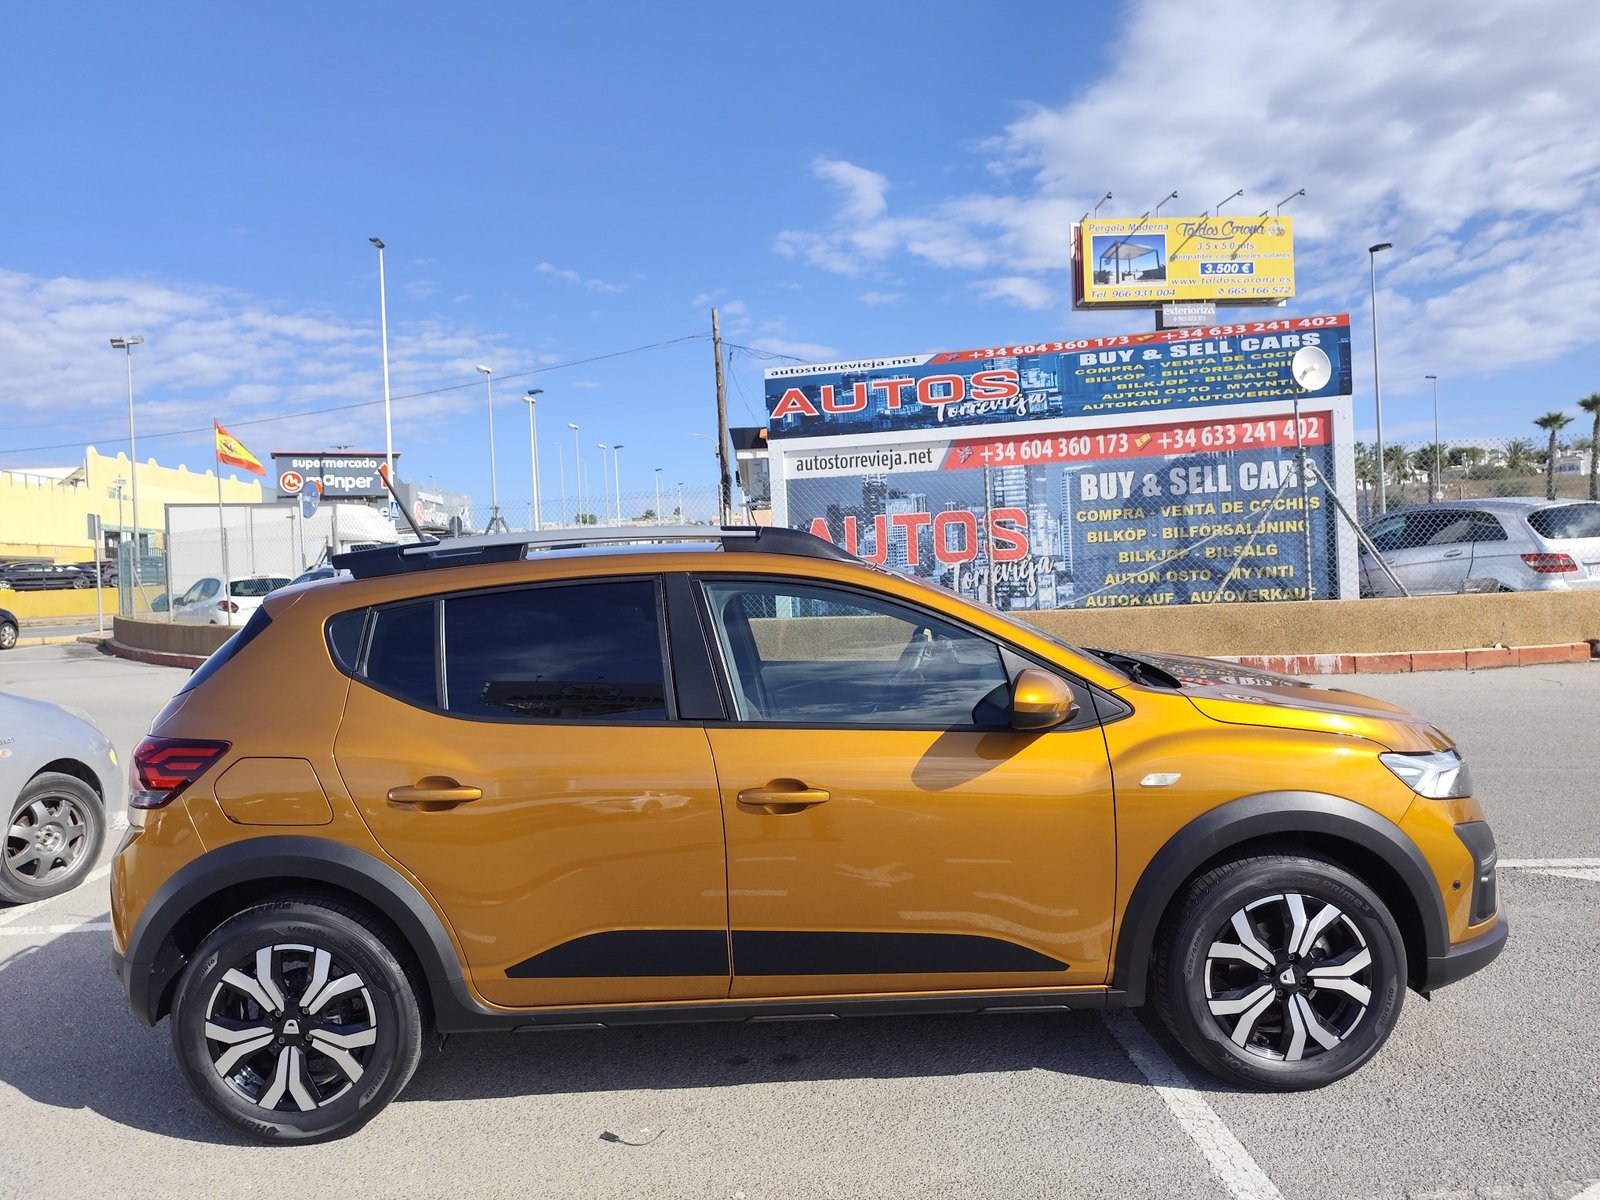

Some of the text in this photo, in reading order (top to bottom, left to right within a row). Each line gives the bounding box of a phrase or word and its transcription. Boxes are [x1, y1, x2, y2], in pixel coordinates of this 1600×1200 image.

[1088, 223, 1169, 233] Pergola Moderna
[1176, 221, 1264, 238] Toldos Corona
[1204, 263, 1251, 274] 3.500 €
[1228, 287, 1247, 295] 665
[1272, 286, 1291, 294] 572
[1163, 305, 1216, 315] exterioriza
[1161, 316, 1338, 340] +34 633 241 402
[969, 336, 1130, 359] +34 604 360 173
[1080, 332, 1321, 366] BUY & SELL CARS
[770, 356, 917, 376] autostorrevieja.net
[1075, 364, 1144, 375] COMPRA
[1160, 357, 1216, 368] VENTA
[1222, 355, 1245, 363] DE
[1085, 372, 1145, 384] BILKÖP
[1161, 360, 1292, 377] BILFÖRSÄLJNI
[1102, 390, 1159, 400] AUTON
[1165, 386, 1210, 395] OSTO
[1227, 379, 1293, 390] MYYNTI
[1117, 378, 1189, 390] BILKJØP
[1205, 370, 1279, 383] BILSALG
[770, 369, 1020, 418] AUTOS
[1082, 398, 1172, 411] AUTOKAUF
[1188, 388, 1313, 402] AUTOVERKAU
[932, 391, 1046, 423] Torrevieja
[1158, 417, 1319, 449] +34 633 241 402
[980, 433, 1129, 462] +34 604 360 173
[292, 457, 377, 470] supermercado
[796, 448, 933, 472] autostorrevieja.net
[1081, 458, 1318, 501] BUY & SELL CARS
[1076, 508, 1145, 522] COMPRA
[1161, 503, 1216, 518] VENTA
[1221, 501, 1244, 514] DE
[1087, 527, 1147, 543] BILKÖP
[1119, 549, 1189, 563] BILKJØP
[1205, 543, 1278, 559] BILSALG
[1105, 571, 1160, 586] AUTON
[1166, 569, 1212, 582] OSTO
[1230, 565, 1294, 580] MYYNTI
[1086, 593, 1174, 607] AUTOKAUF
